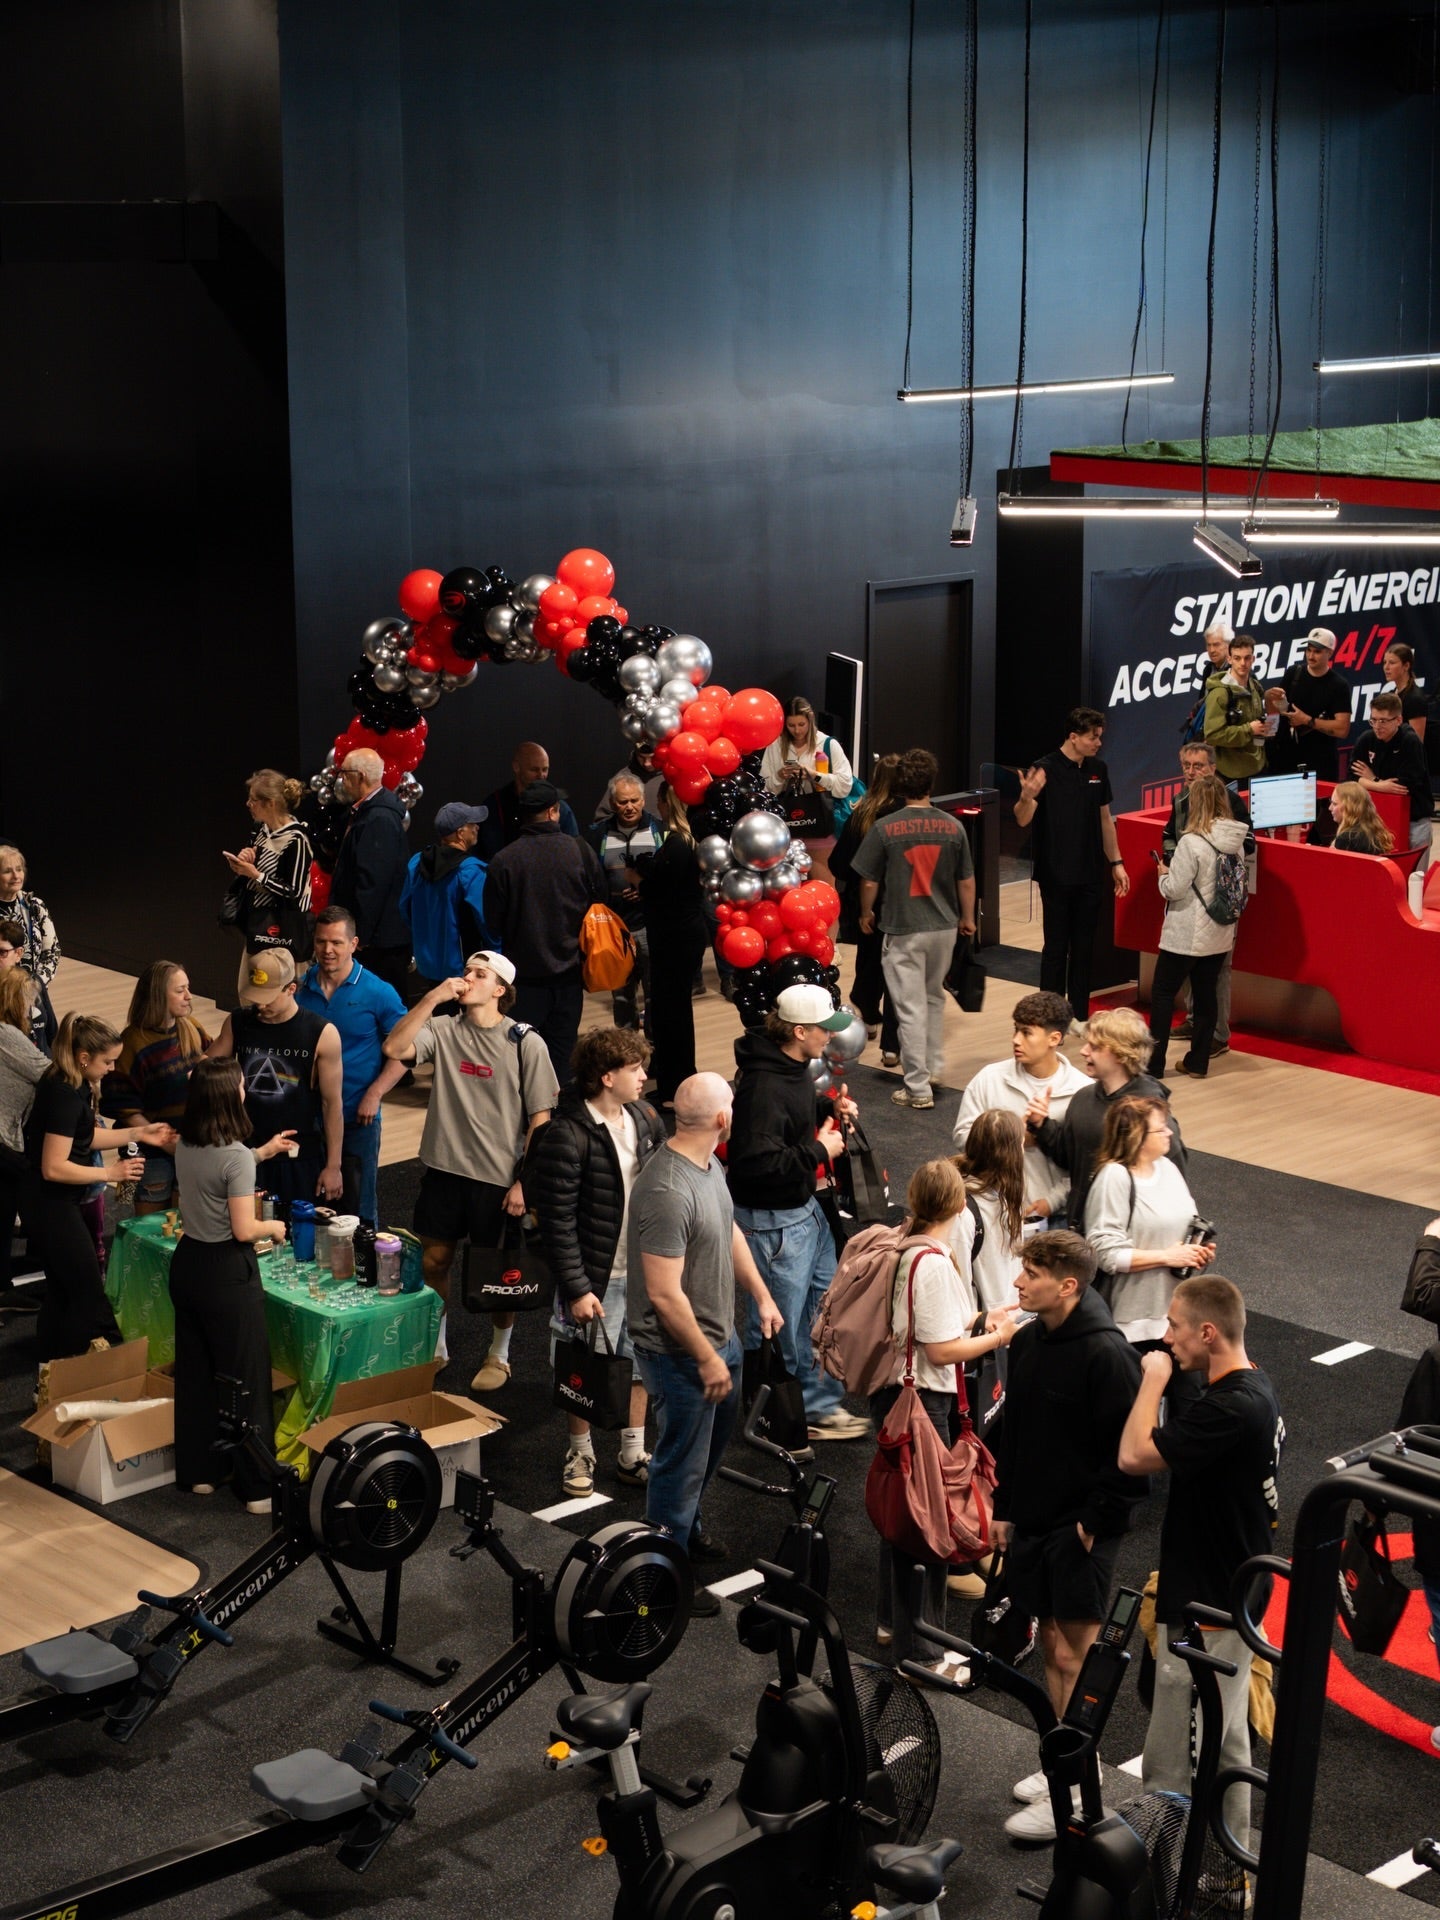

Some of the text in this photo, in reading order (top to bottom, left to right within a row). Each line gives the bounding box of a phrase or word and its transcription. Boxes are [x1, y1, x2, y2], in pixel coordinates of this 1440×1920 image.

[1170, 567, 1440, 636] STATION ÉNERGI
[1109, 638, 1308, 707] ACCESBLE
[1328, 624, 1397, 671] 4/7
[254, 934, 293, 946] PROGYM
[268, 1048, 309, 1058] FLOYD
[481, 1283, 539, 1295] PROGYM
[559, 1383, 594, 1409] PROGYM
[210, 1555, 288, 1626] oncept 2
[452, 1667, 530, 1744] oncept 2
